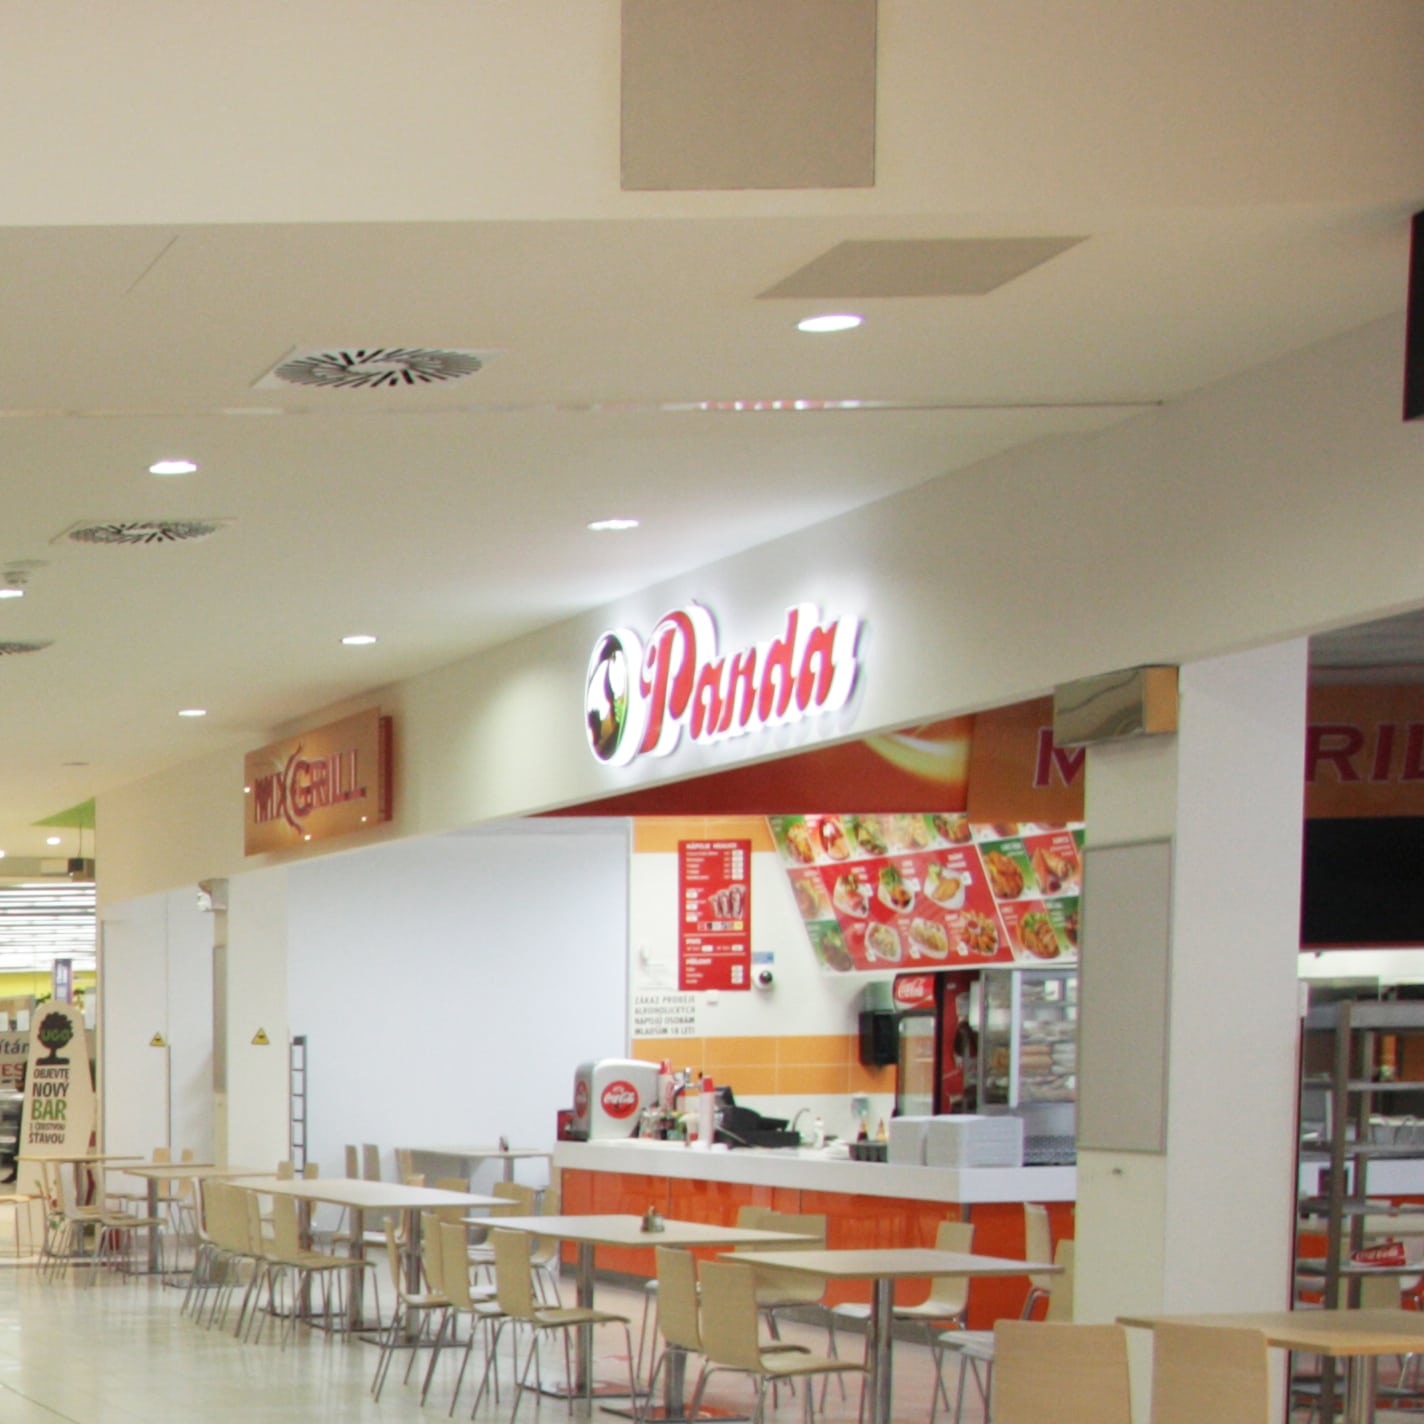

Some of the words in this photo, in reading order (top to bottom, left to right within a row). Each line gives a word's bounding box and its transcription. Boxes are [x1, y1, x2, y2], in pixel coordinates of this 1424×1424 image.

[639, 609, 842, 754] Panda
[291, 749, 366, 818] GRILL
[31, 1099, 67, 1121] BAR
[32, 1080, 69, 1097] NOVÝ
